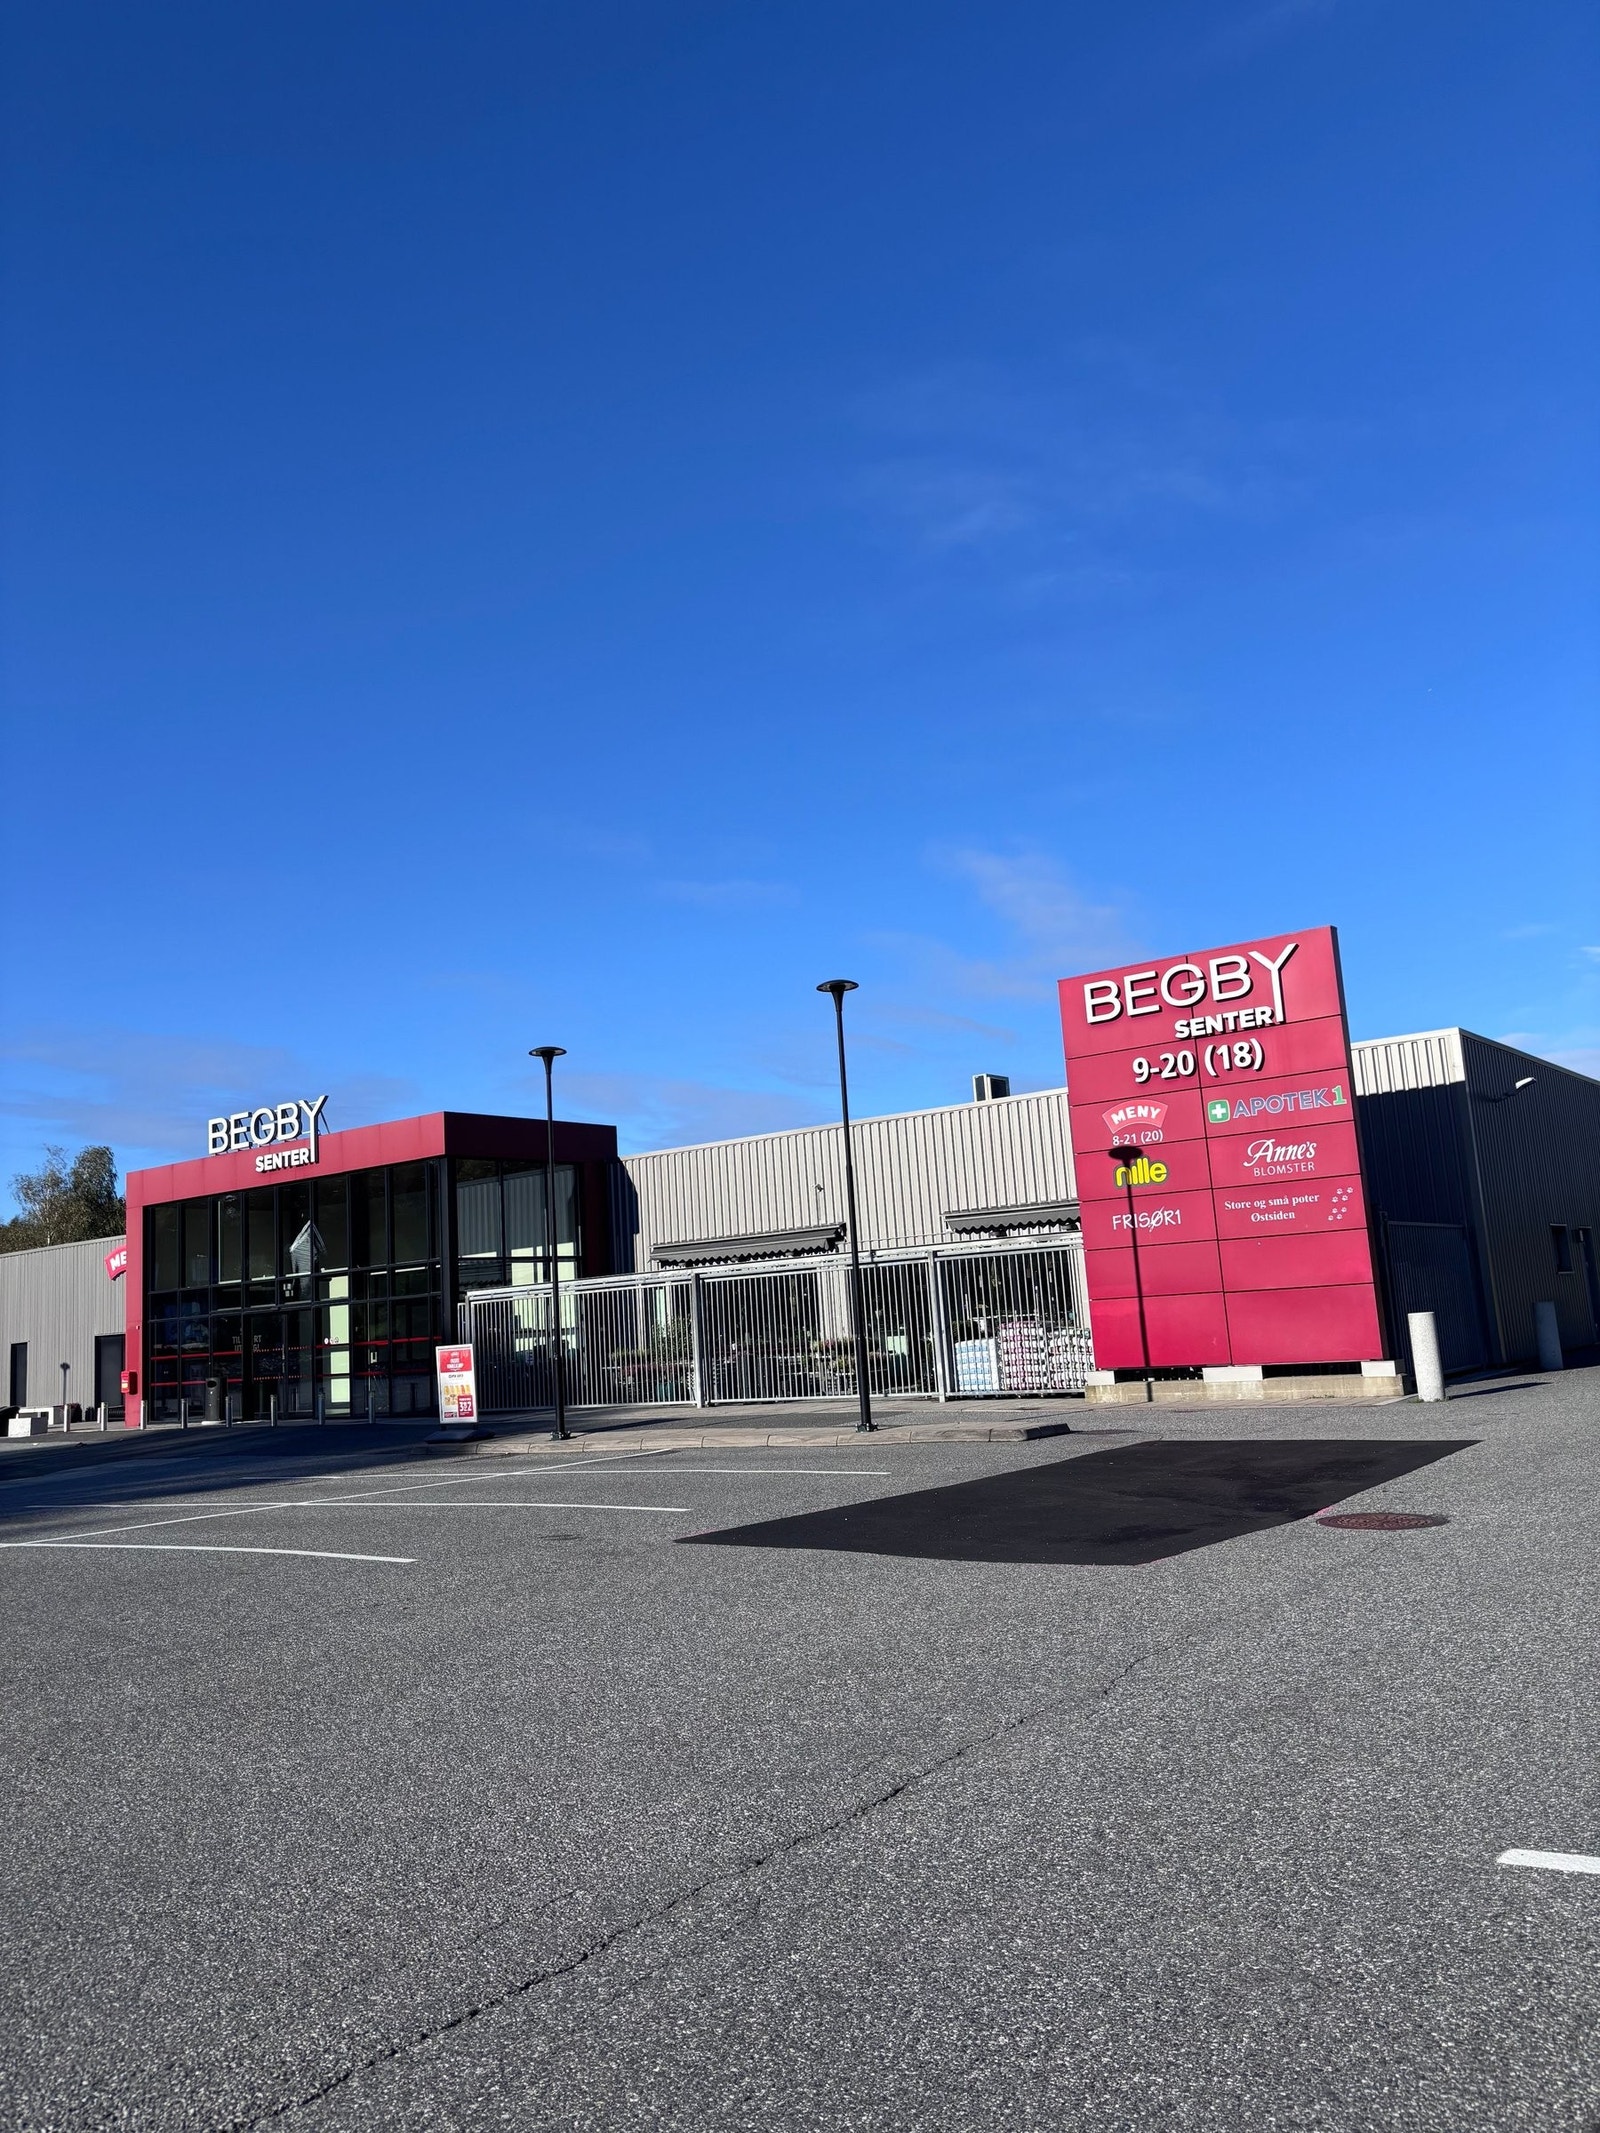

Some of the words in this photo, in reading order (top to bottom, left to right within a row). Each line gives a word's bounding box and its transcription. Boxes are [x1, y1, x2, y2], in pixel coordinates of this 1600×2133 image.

[1083, 942, 1298, 1025] BEGBY
[1175, 1005, 1272, 1039] SENTER
[1132, 1050, 1195, 1084] 9-20
[1205, 1038, 1263, 1077] (18)
[1110, 1104, 1161, 1125] MENY
[208, 1095, 328, 1162] BEGBY
[1112, 1133, 1137, 1147] 8-21
[1140, 1129, 1164, 1144] (20)
[256, 1148, 310, 1172] SENTER
[1243, 1139, 1317, 1167] Anne's
[1115, 1157, 1167, 1187] nille
[1253, 1162, 1315, 1177] BLOMSTER
[1224, 1199, 1251, 1211] Store
[1253, 1200, 1266, 1210] og
[1267, 1195, 1290, 1207] små
[1291, 1193, 1320, 1208] poter
[1251, 1209, 1295, 1223] Østsiden
